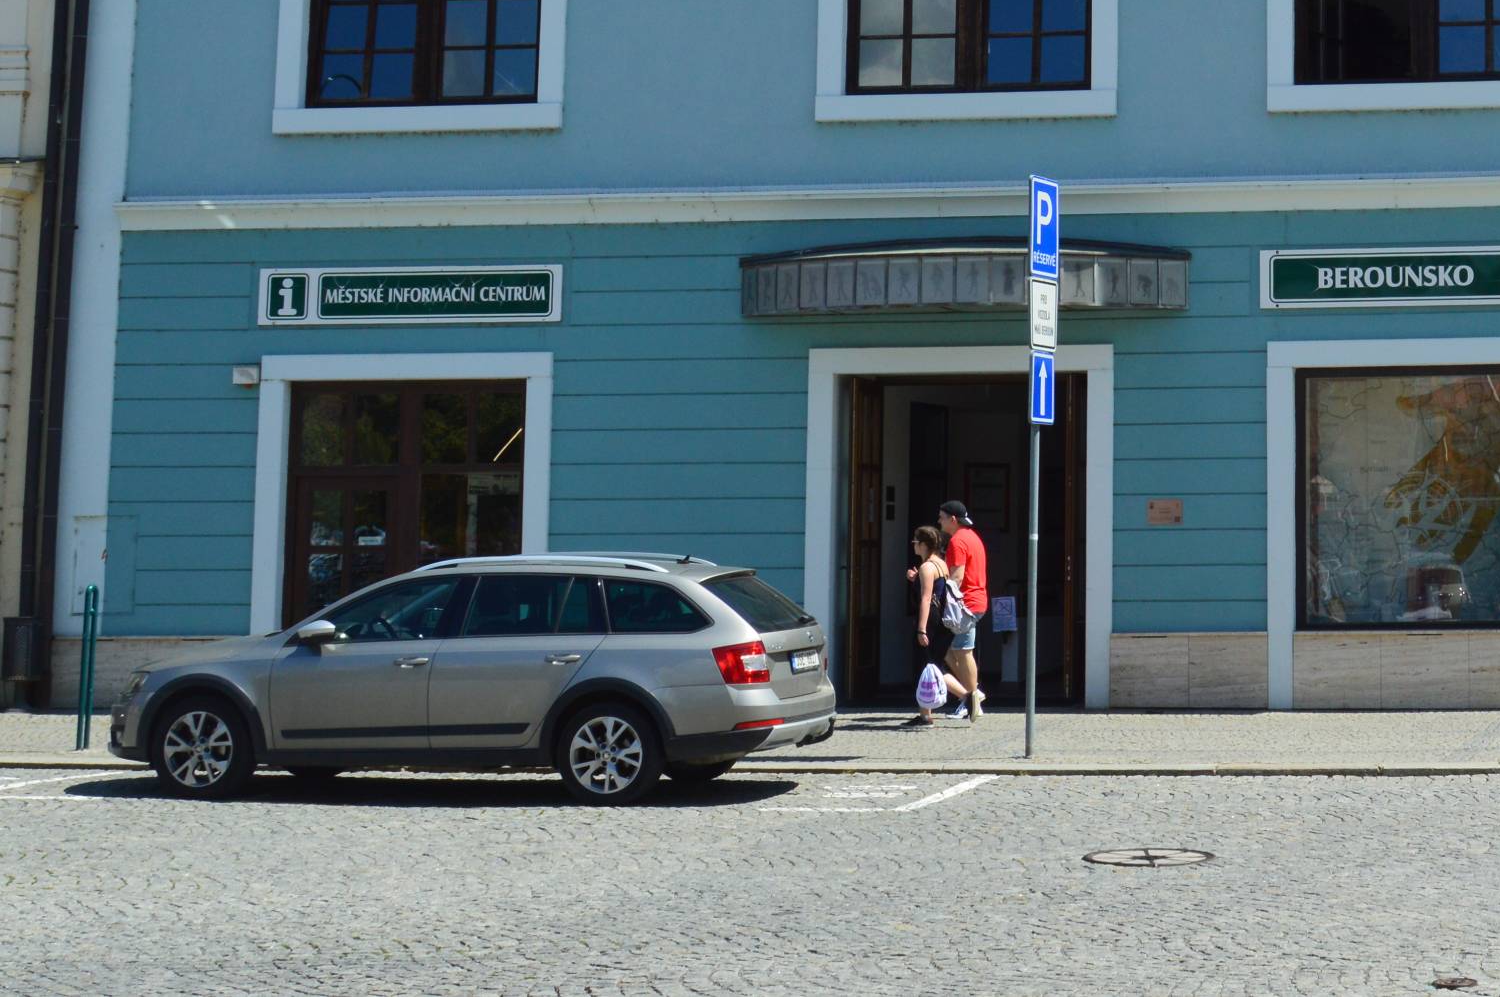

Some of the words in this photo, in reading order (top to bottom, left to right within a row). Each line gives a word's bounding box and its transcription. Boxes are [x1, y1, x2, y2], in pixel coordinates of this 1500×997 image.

[1036, 190, 1053, 245] P
[1033, 250, 1056, 267] RÉSERVÉ
[1318, 265, 1474, 289] BEROUNSKO
[325, 284, 384, 304] MĚSTSKÉ
[388, 283, 475, 303] INFORMAČNÍ
[479, 285, 545, 302] CENTRUM
